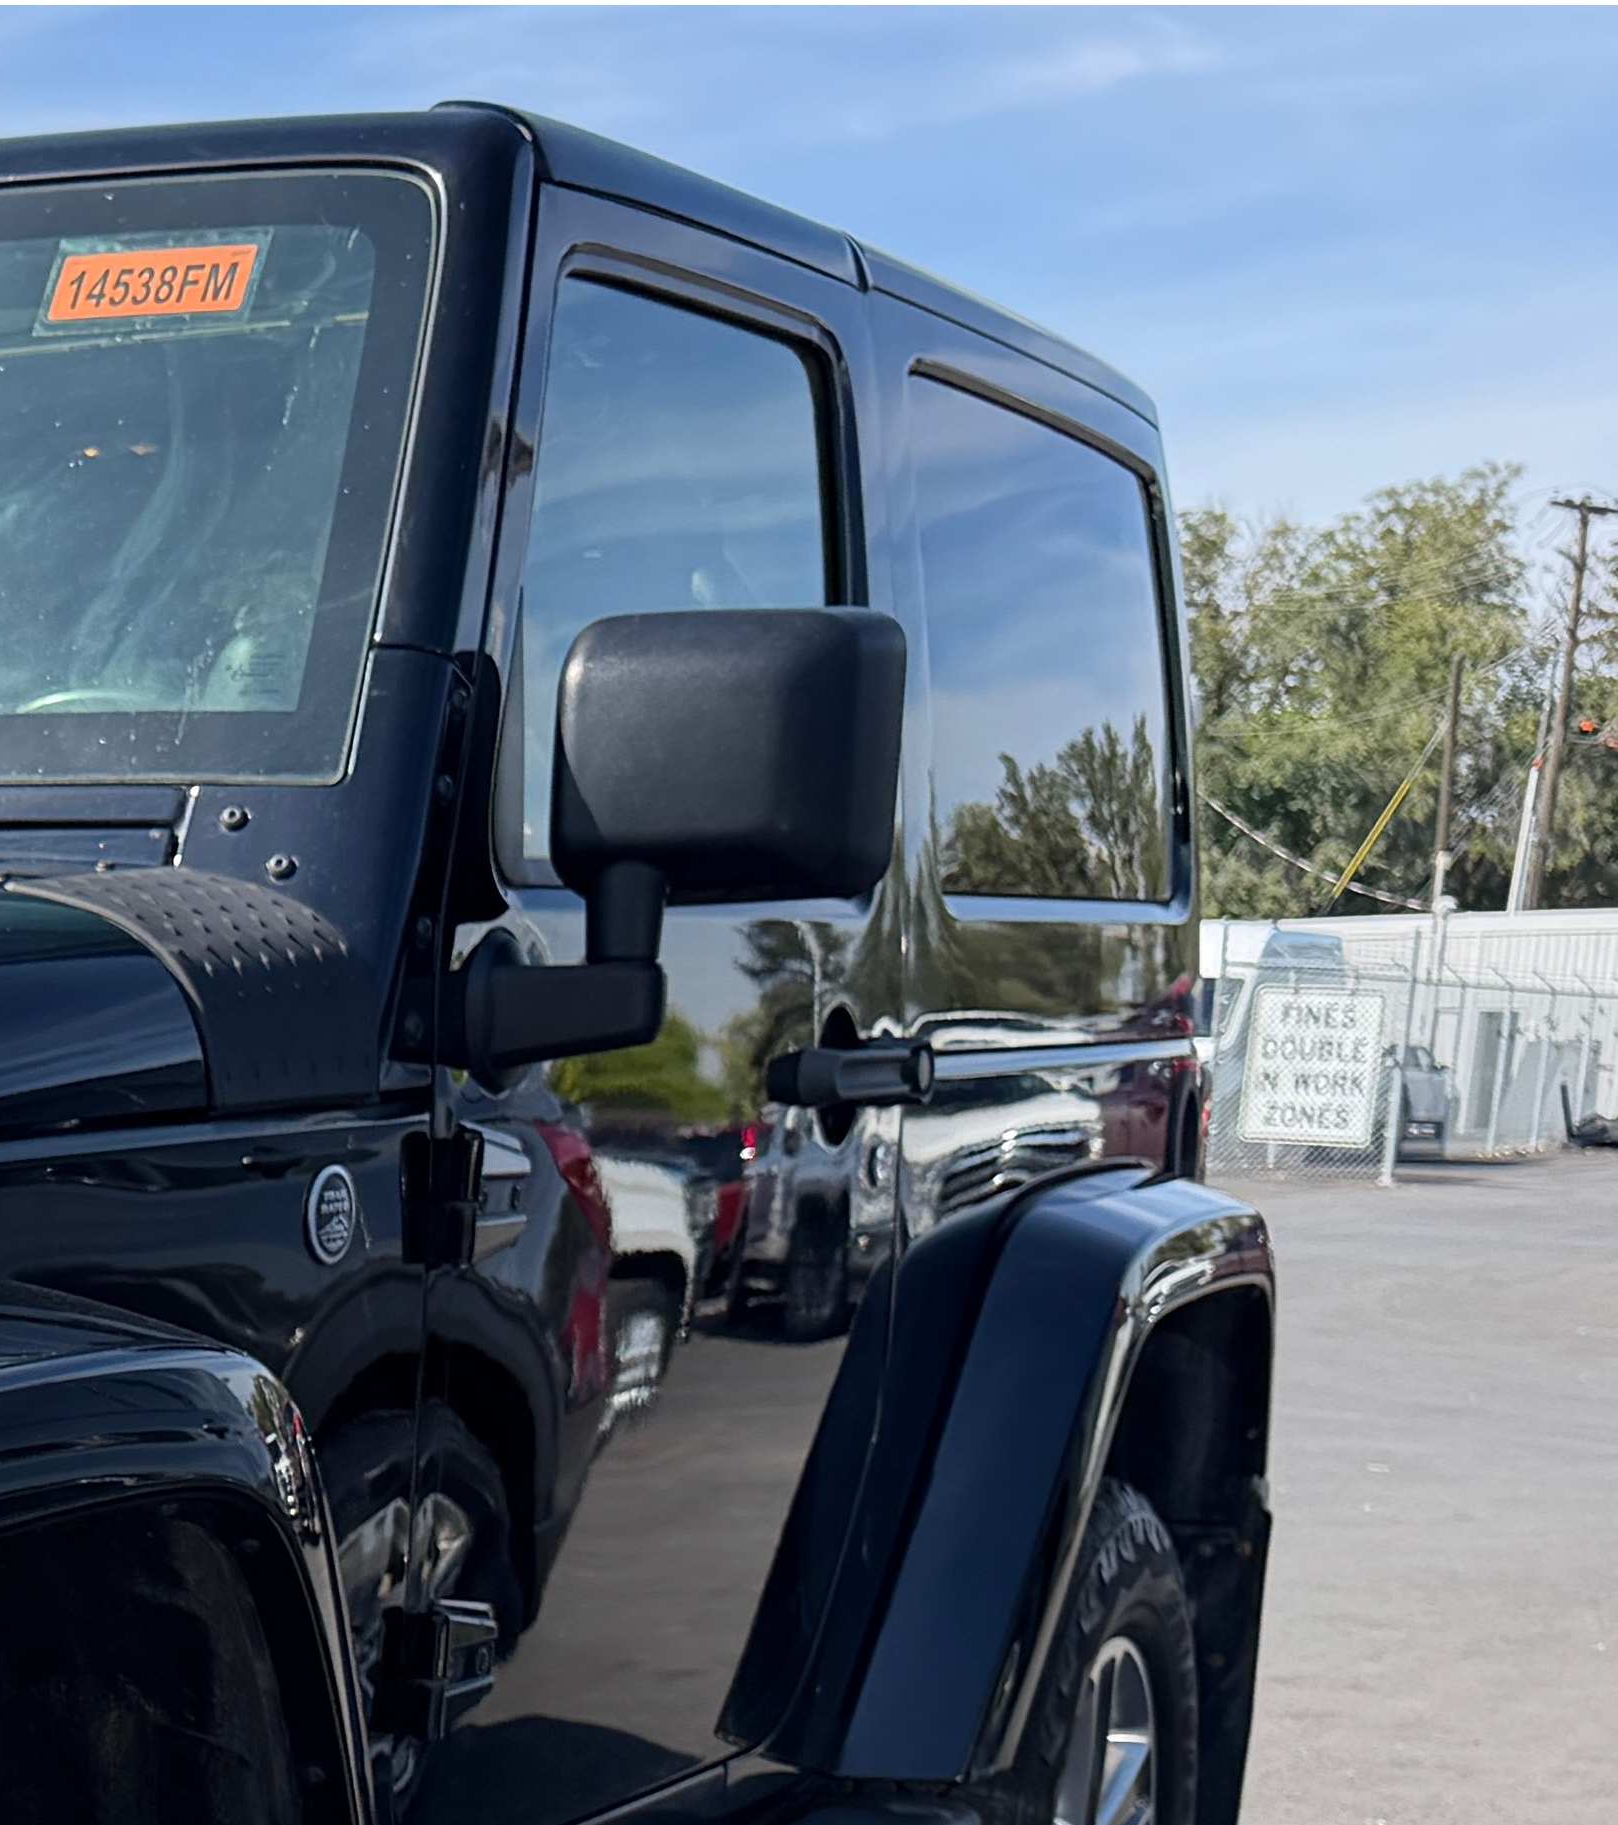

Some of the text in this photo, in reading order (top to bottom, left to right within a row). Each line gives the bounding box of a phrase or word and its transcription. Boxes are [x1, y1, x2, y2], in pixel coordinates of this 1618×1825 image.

[68, 260, 240, 310] 14538FM
[1279, 1001, 1358, 1030] FINES
[1261, 1034, 1369, 1063] DOUBLE
[1293, 1070, 1365, 1097] WORK
[1263, 1100, 1350, 1130] ZONES
